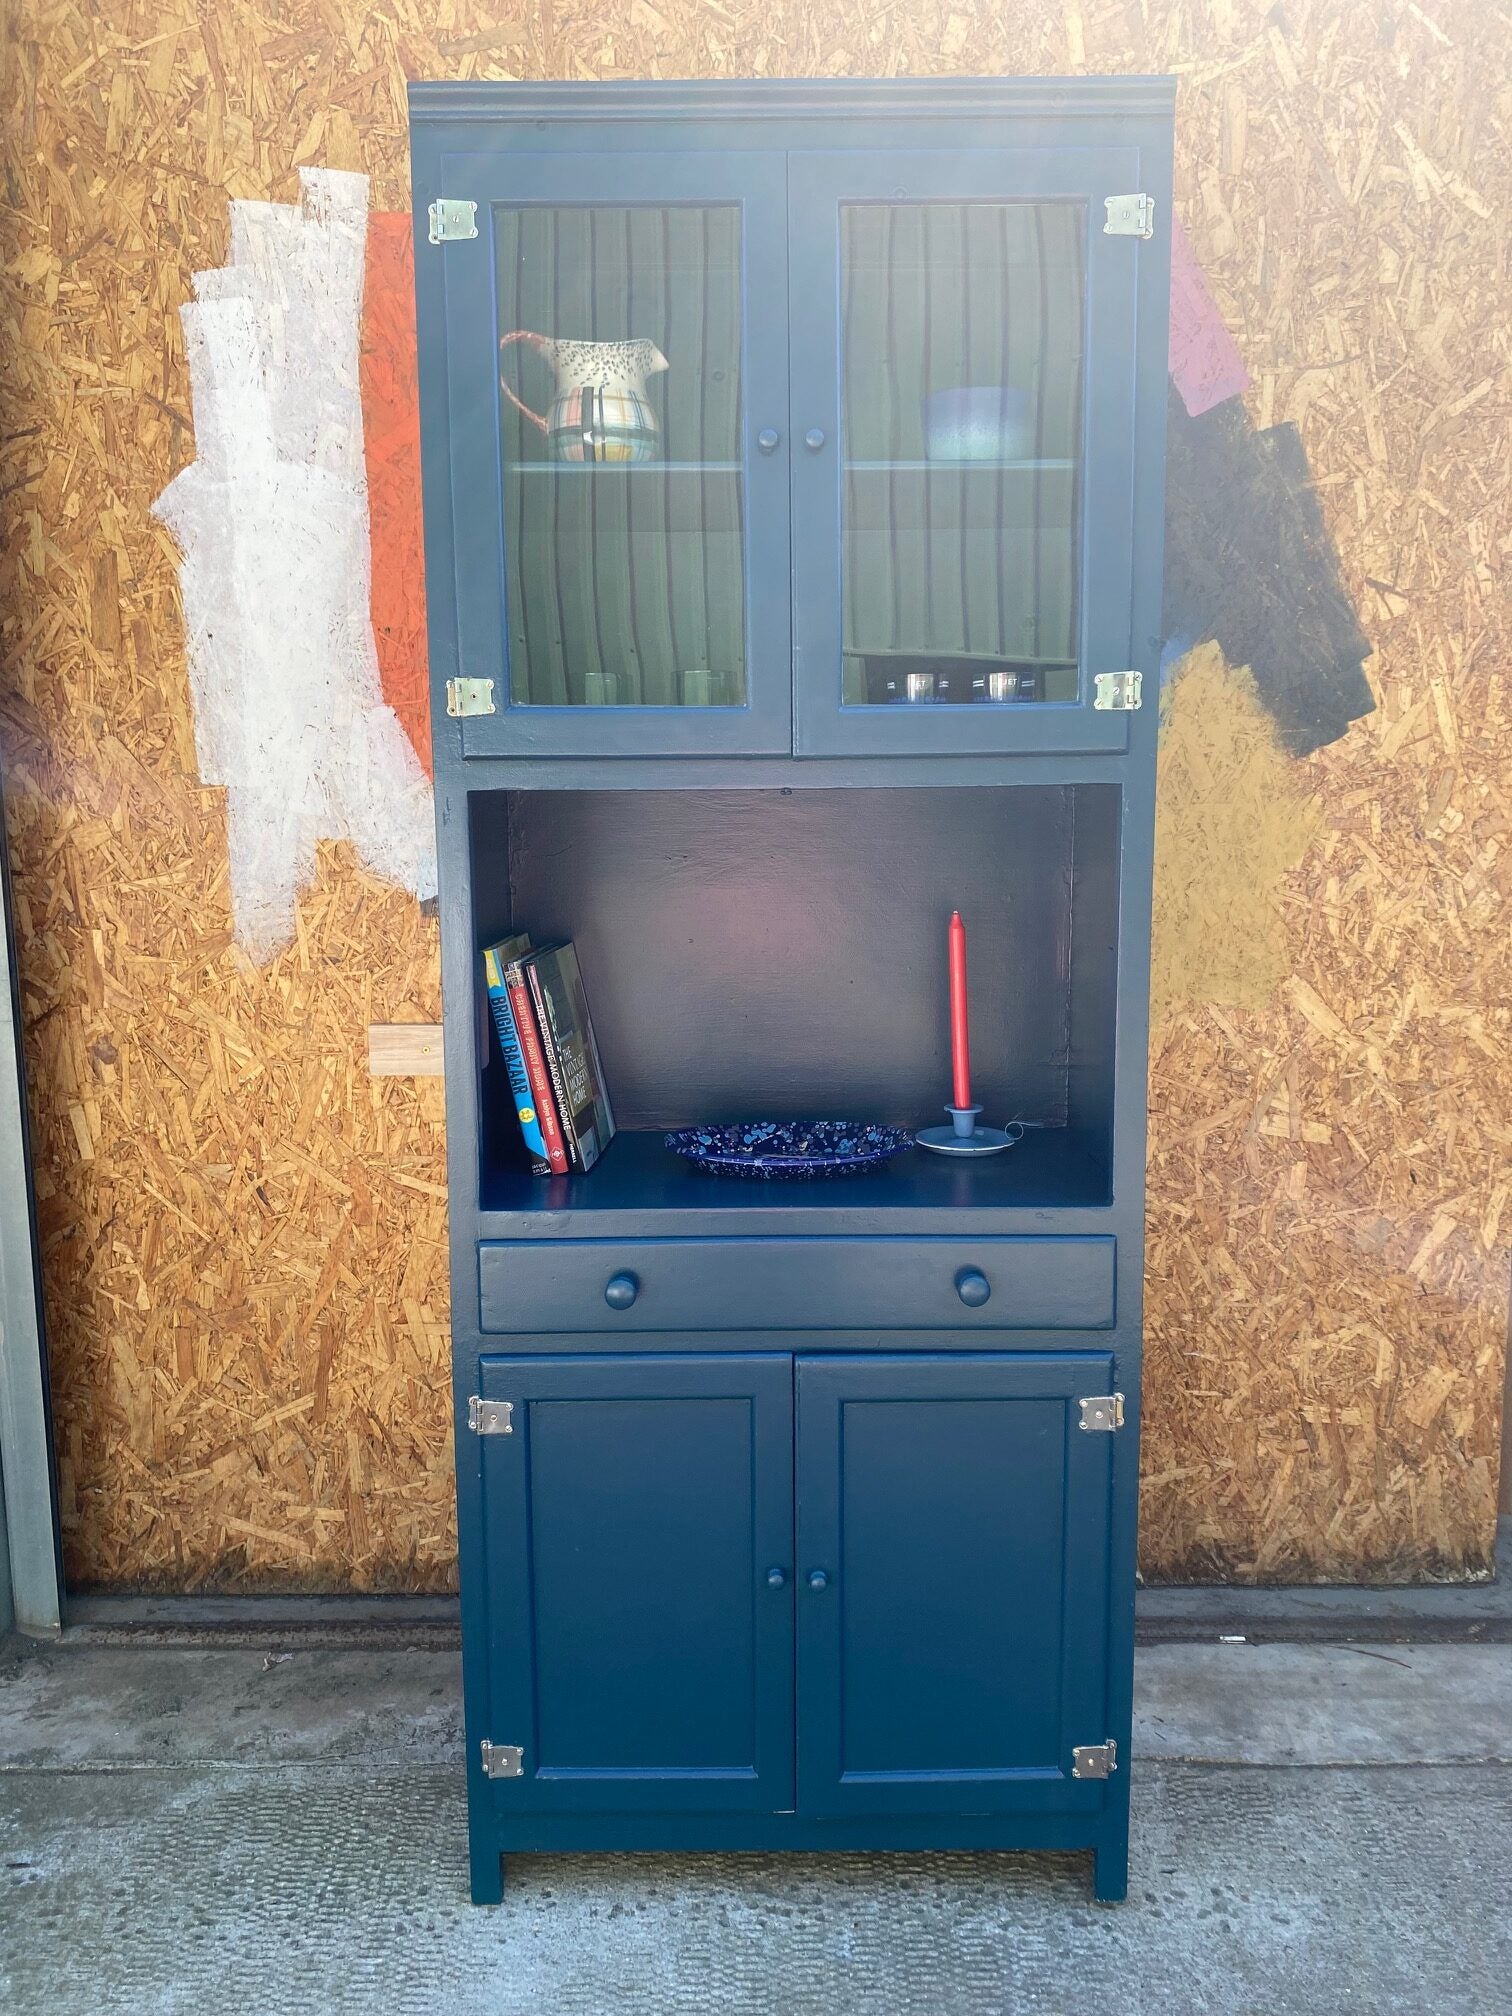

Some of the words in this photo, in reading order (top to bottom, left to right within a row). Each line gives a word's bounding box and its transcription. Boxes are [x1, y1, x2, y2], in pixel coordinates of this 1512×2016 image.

[1002, 678, 1017, 686] JET
[491, 995, 516, 1043] BRIGHT
[515, 993, 532, 1035] CREATIVE
[536, 1004, 546, 1020] THE
[526, 1037, 539, 1065] FAMILY
[539, 1020, 556, 1063] VINTAGE
[503, 1045, 528, 1095] BAZAAR
[532, 1067, 545, 1091] HOME
[549, 1063, 565, 1102] MODERN
[558, 1103, 571, 1130] HOME
